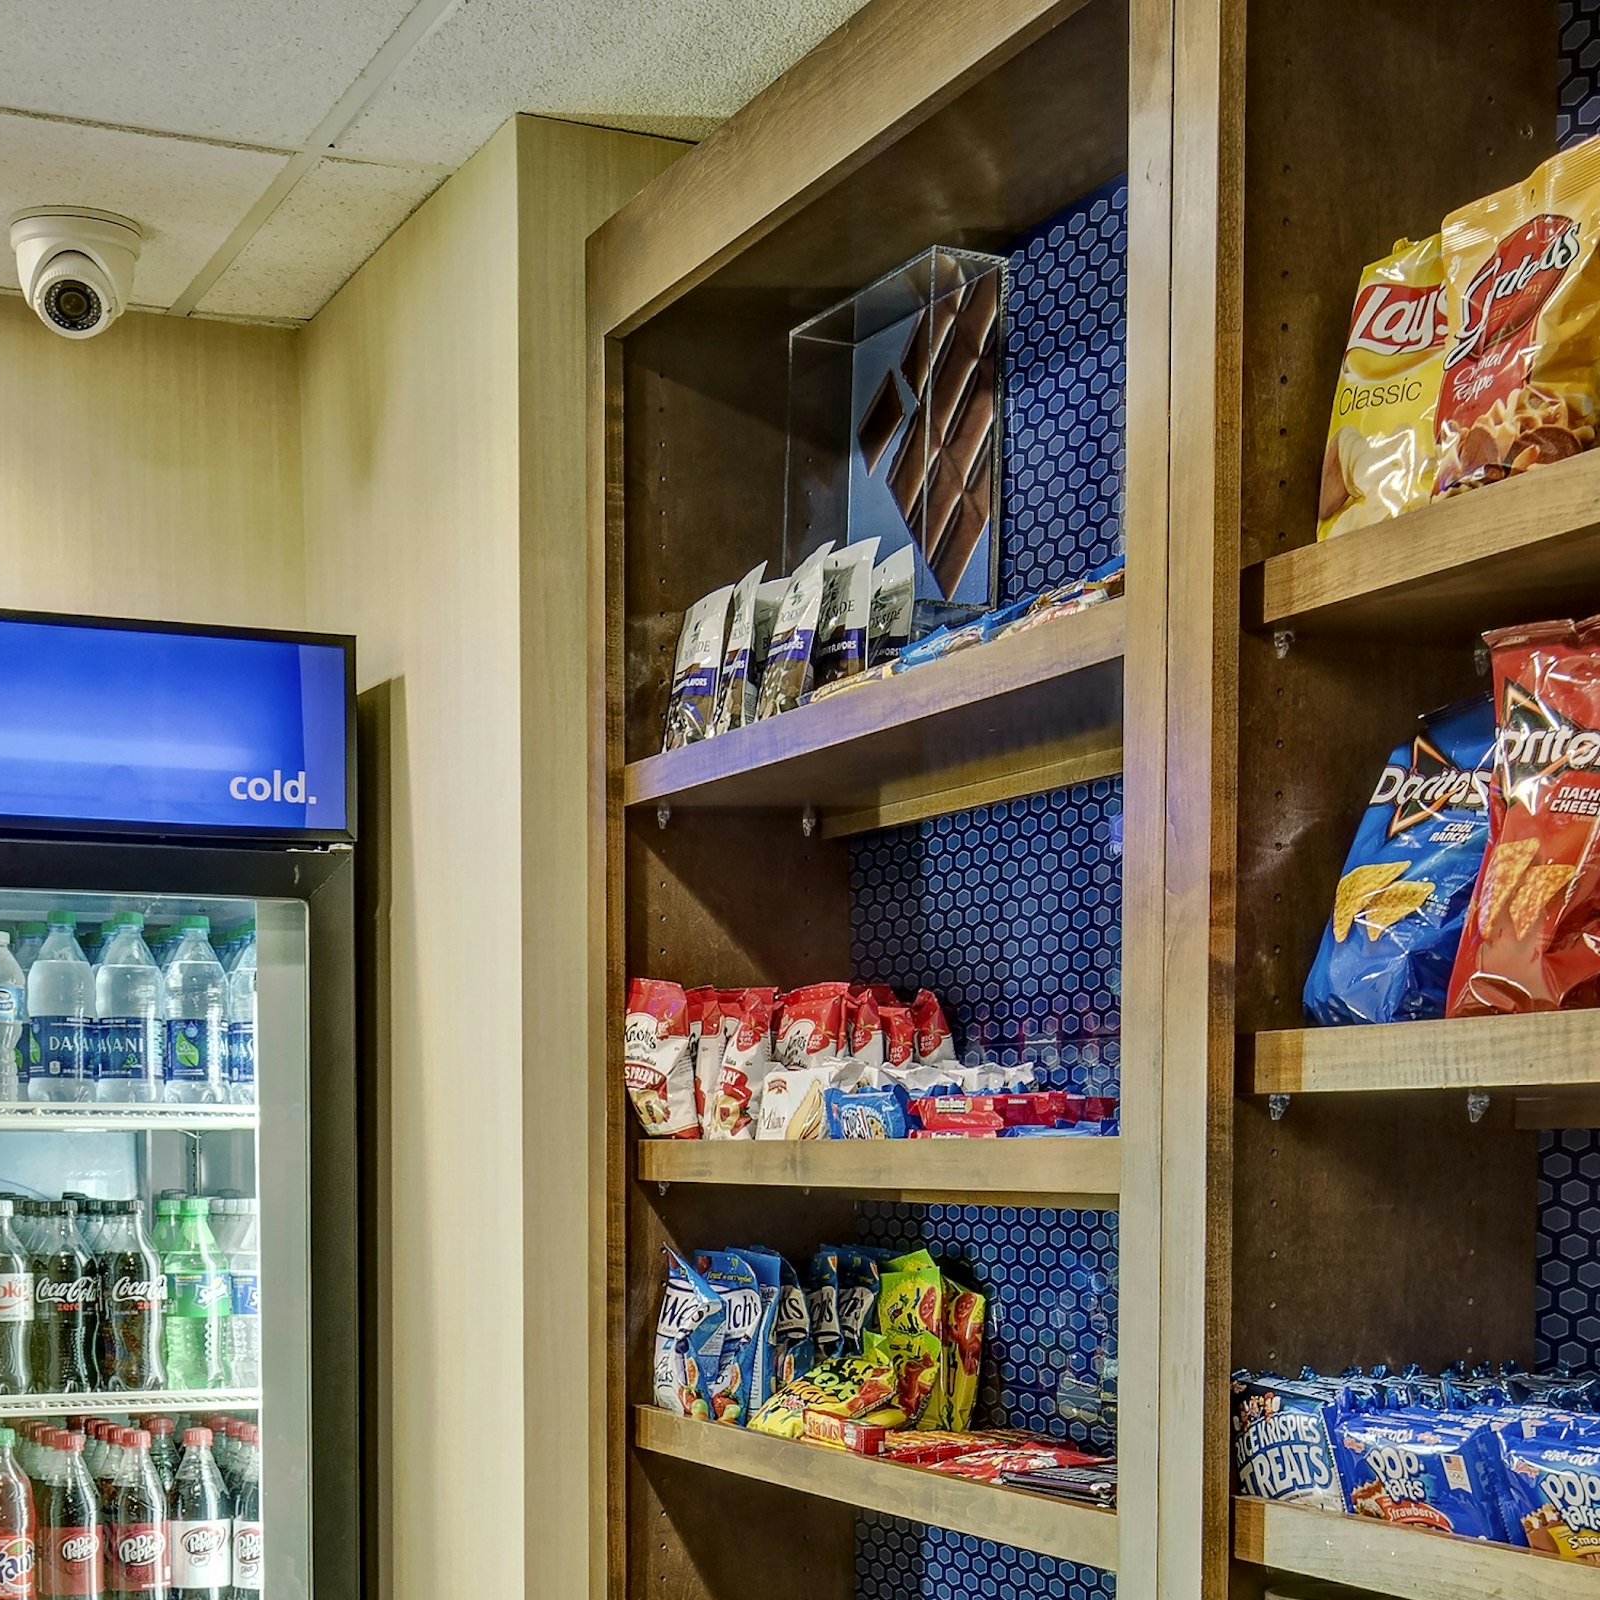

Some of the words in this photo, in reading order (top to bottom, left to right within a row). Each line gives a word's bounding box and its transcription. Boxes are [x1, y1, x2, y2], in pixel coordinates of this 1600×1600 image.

[1338, 377, 1422, 416] Classic
[228, 770, 318, 807] cold.
[1369, 766, 1492, 806] Doritos
[1240, 1444, 1333, 1498] TREATS
[1386, 1506, 1441, 1523] Strawberry
